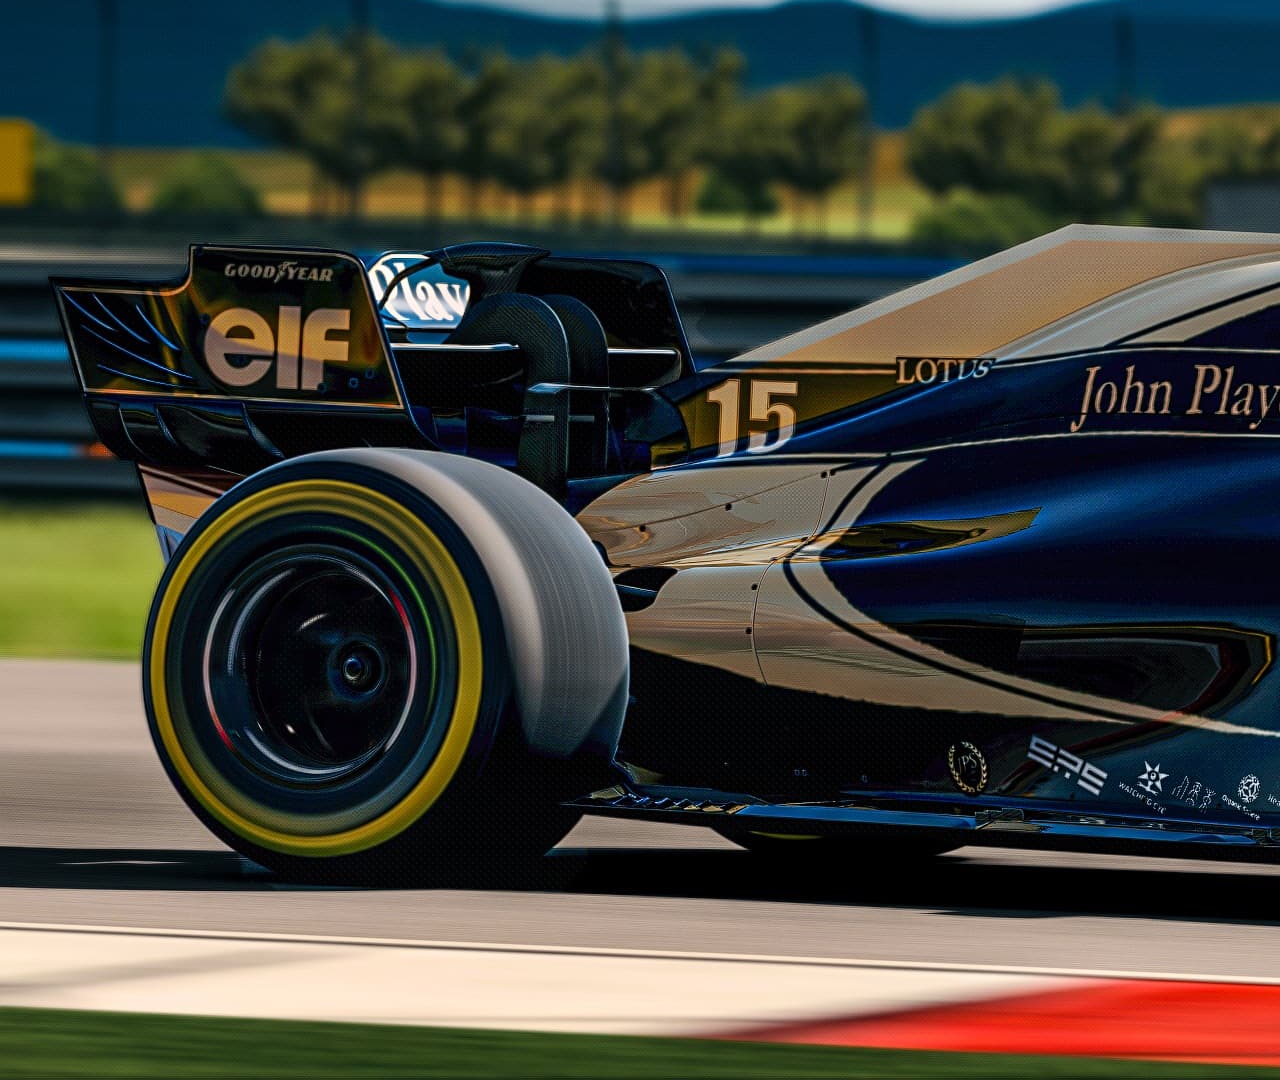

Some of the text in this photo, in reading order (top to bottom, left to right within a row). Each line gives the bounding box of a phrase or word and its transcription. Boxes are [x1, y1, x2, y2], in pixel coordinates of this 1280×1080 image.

[224, 261, 334, 284] GOODYEAR
[204, 305, 351, 391] elf
[896, 358, 994, 385] LOTUS
[705, 378, 799, 458] 15
[1070, 364, 1173, 433] John
